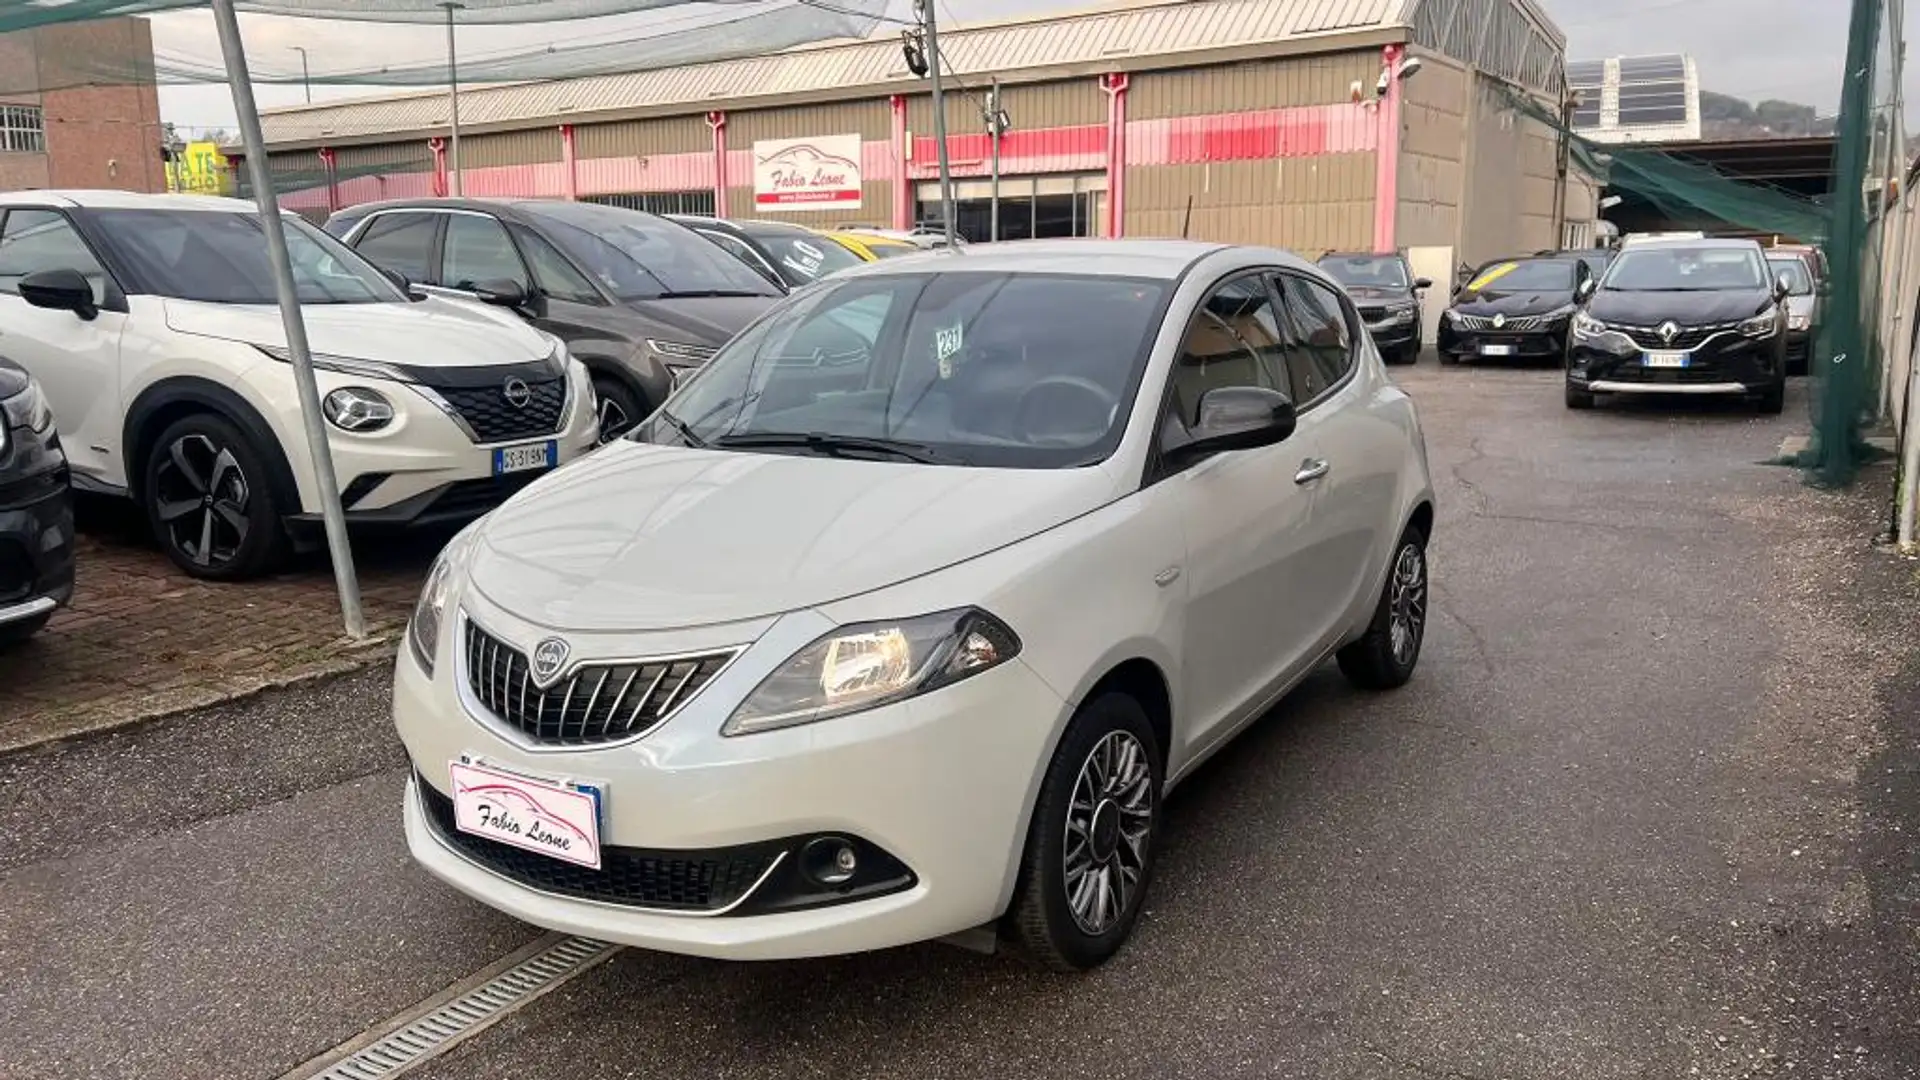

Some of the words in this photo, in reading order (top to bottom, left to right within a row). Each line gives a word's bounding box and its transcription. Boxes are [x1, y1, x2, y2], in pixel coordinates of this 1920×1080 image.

[771, 169, 806, 191] Fabio
[810, 167, 845, 186] Leone
[478, 804, 521, 834] Fabio
[525, 820, 572, 851] Leone
